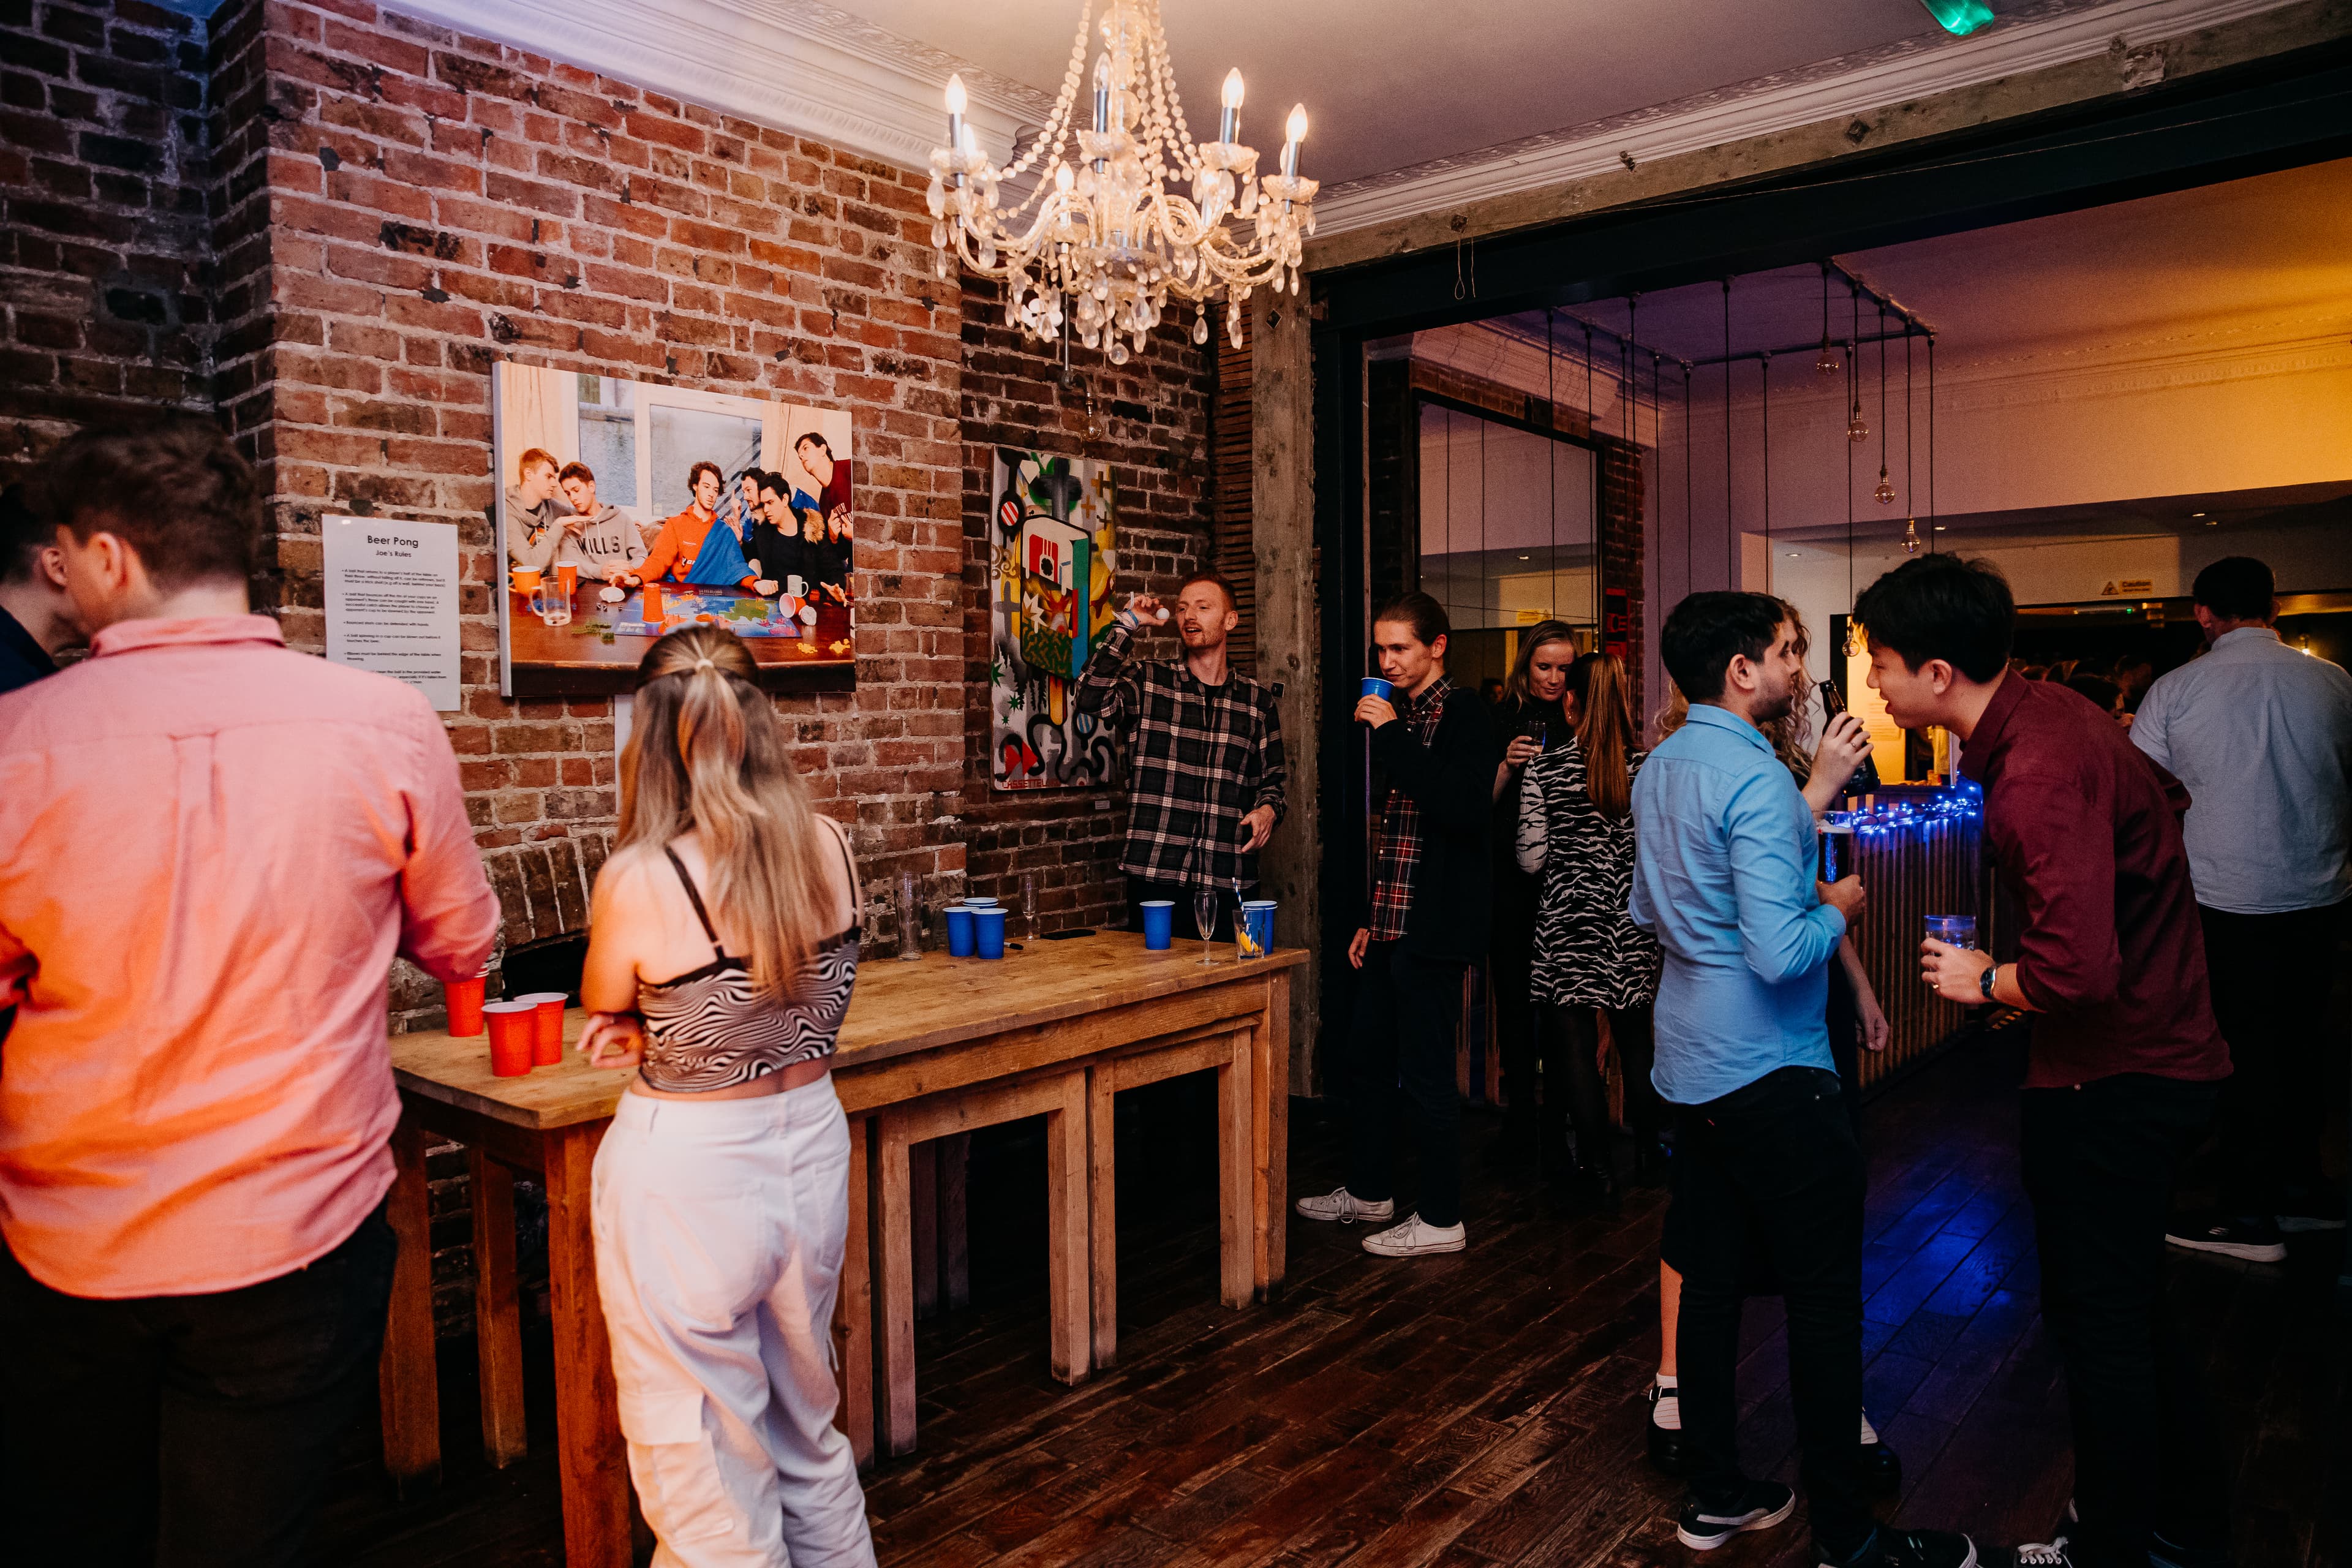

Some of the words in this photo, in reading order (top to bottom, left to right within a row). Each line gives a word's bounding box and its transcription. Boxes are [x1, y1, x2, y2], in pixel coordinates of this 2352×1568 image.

[368, 535, 390, 545] Beer
[394, 537, 418, 548] Pong
[576, 536, 620, 556] WILLS
